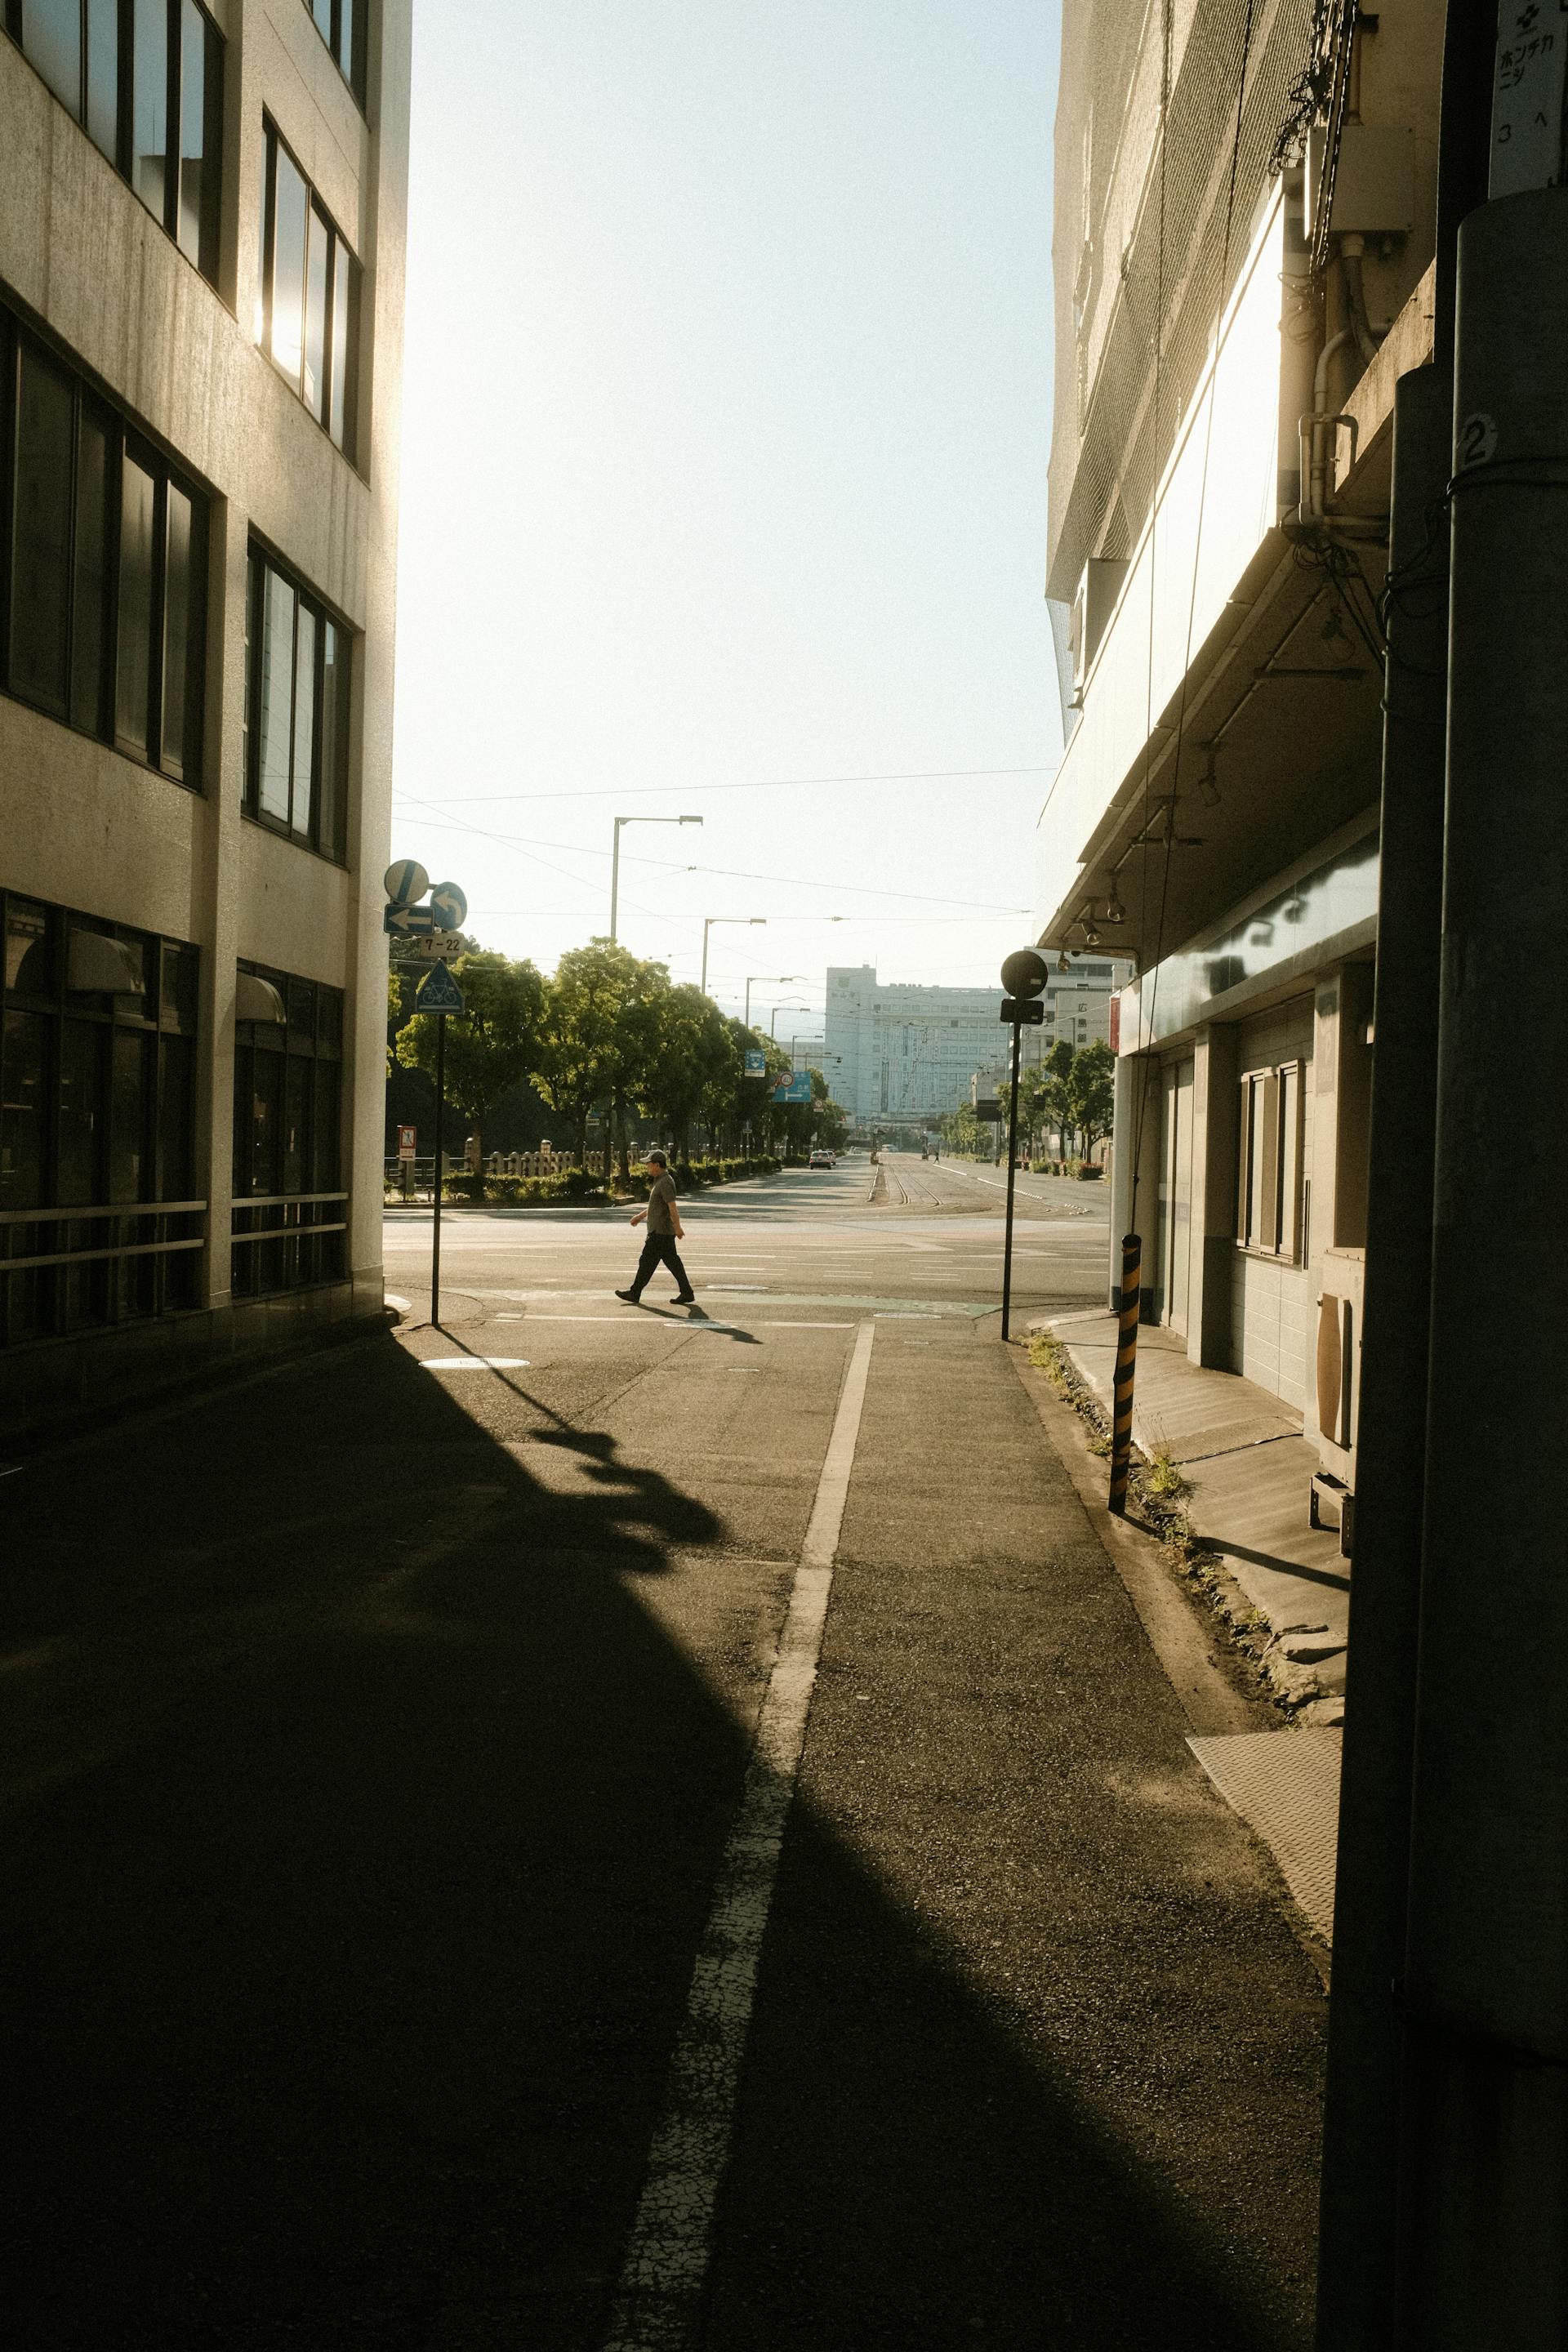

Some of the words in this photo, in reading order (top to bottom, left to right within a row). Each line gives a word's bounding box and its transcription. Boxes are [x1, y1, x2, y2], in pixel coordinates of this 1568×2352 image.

[1500, 33, 1554, 69] ホンチカ
[1465, 419, 1486, 465] 2
